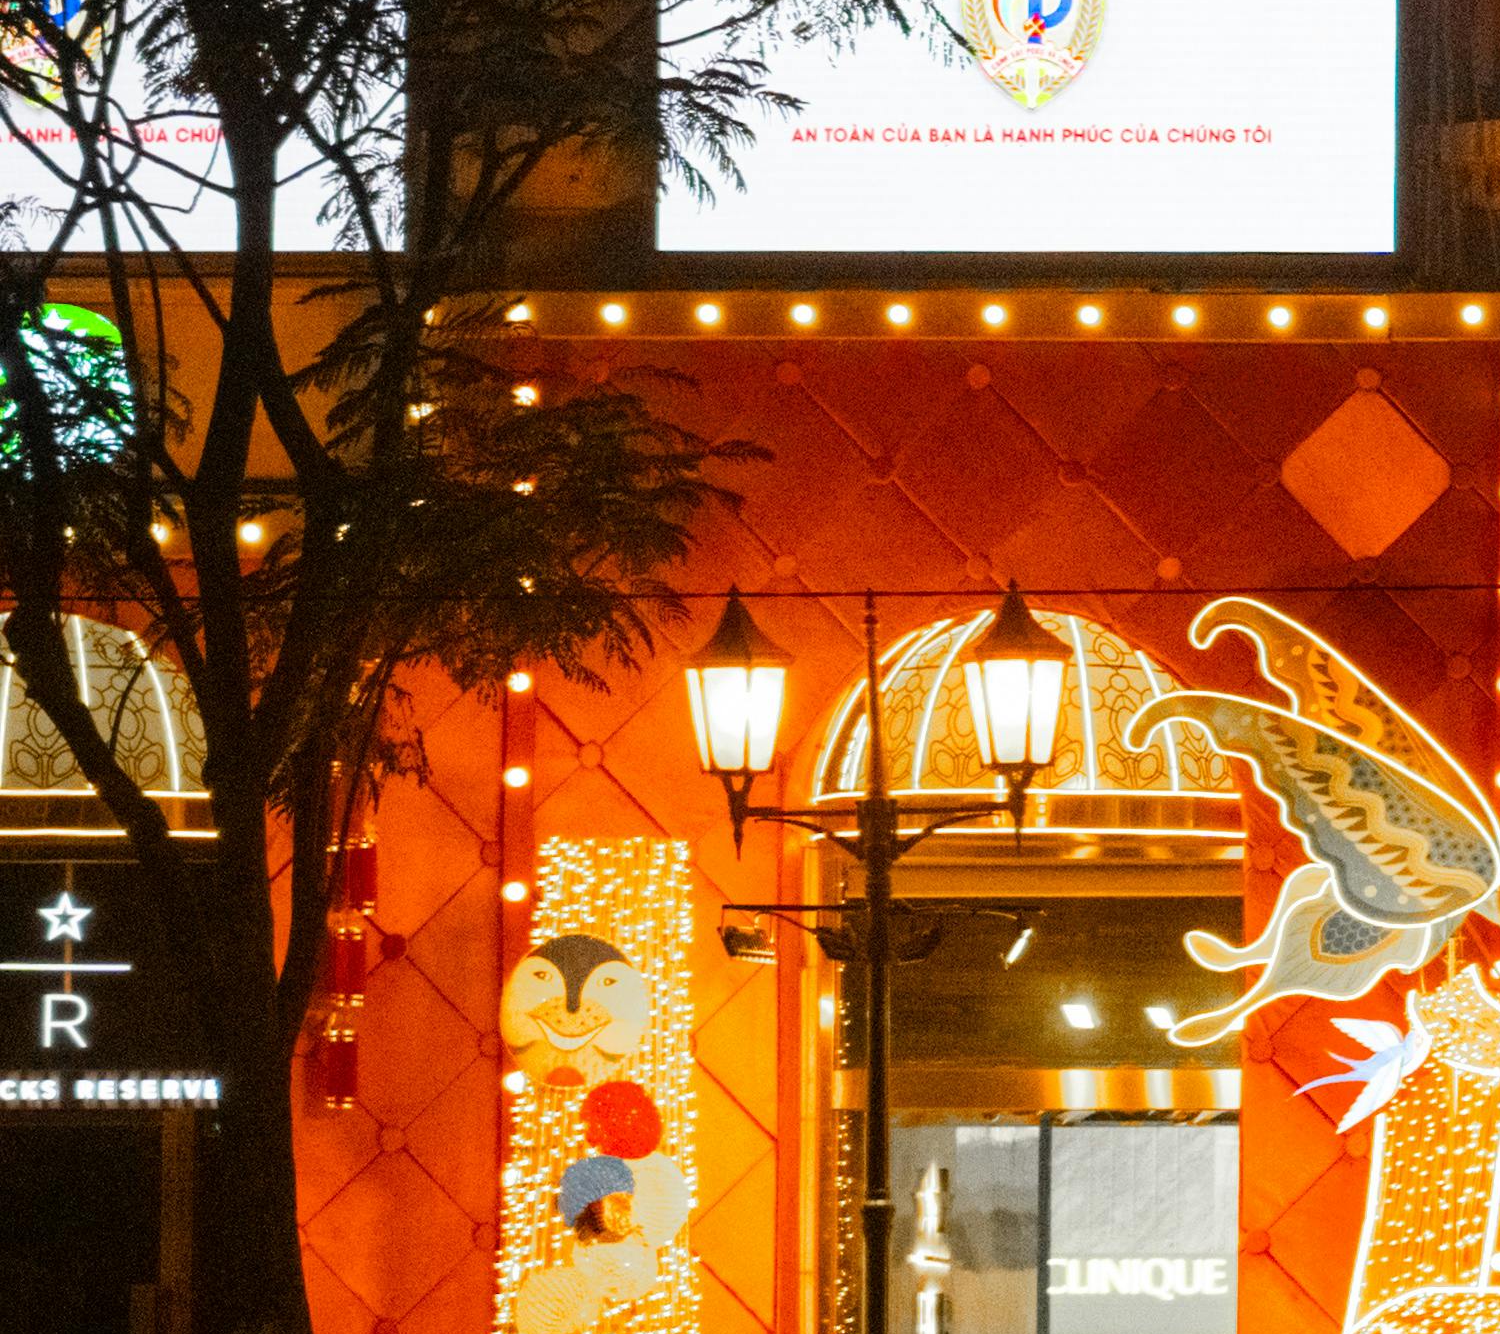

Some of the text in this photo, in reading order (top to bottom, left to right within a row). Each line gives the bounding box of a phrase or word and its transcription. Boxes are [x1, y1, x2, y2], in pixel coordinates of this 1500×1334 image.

[791, 127, 818, 143] AN
[824, 123, 876, 143] TOÀN
[882, 123, 922, 143] CỦA
[974, 123, 996, 143] LÀ
[1062, 123, 1113, 143] PHÚC
[1120, 123, 1161, 143] CỦA
[1167, 123, 1237, 143] CHÚNG
[1243, 123, 1273, 143] TÔI
[42, 993, 89, 1049] R
